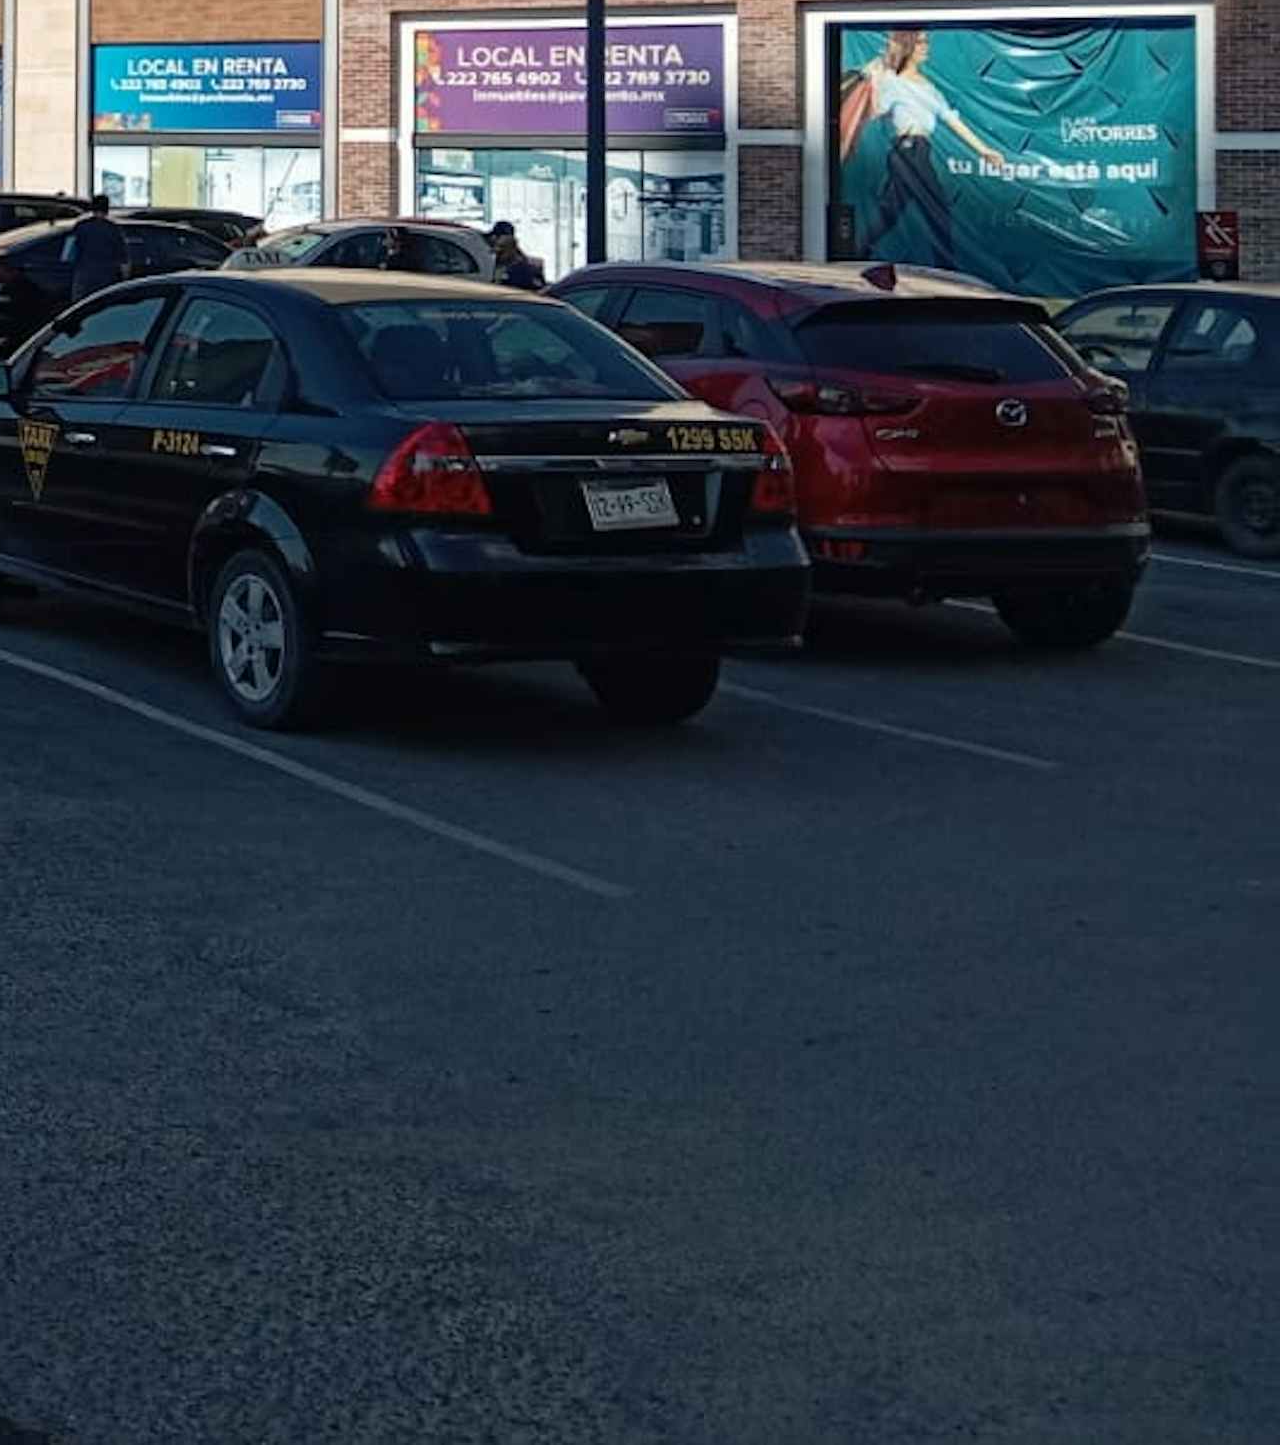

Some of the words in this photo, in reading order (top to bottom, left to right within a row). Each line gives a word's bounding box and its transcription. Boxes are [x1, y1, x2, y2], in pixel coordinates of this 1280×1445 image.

[127, 58, 188, 76] LOCAL
[192, 58, 219, 75] EN
[223, 57, 288, 76] RENTA
[457, 46, 542, 67] LOCAL
[550, 46, 585, 66] EN
[605, 45, 684, 67] ENTA
[447, 71, 477, 85] 222
[947, 158, 972, 174] tu
[979, 159, 1042, 181] lugar
[666, 426, 716, 451] 1299
